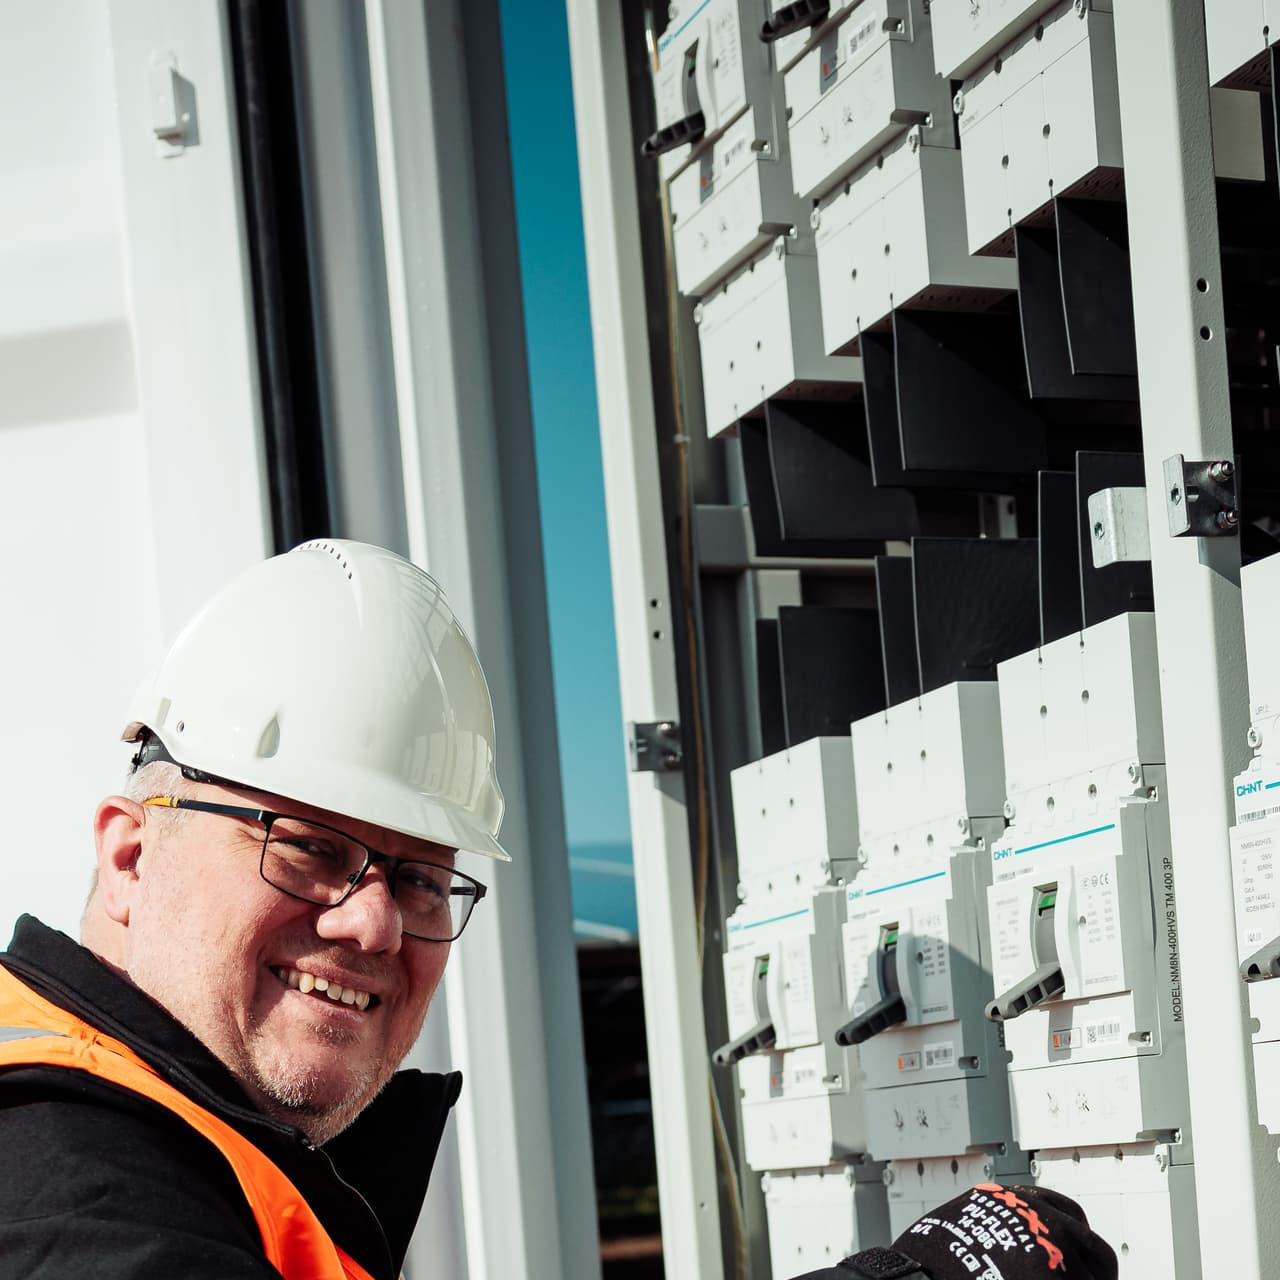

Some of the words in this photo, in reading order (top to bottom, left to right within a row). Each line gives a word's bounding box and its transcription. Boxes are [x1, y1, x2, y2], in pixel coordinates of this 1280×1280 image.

[1162, 856, 1173, 871] 3P
[1164, 871, 1175, 890] 400
[1165, 890, 1176, 908] TM
[1166, 908, 1183, 1023] MODEL:NM8N-400HVS
[961, 1203, 1018, 1251] PU-FLEX
